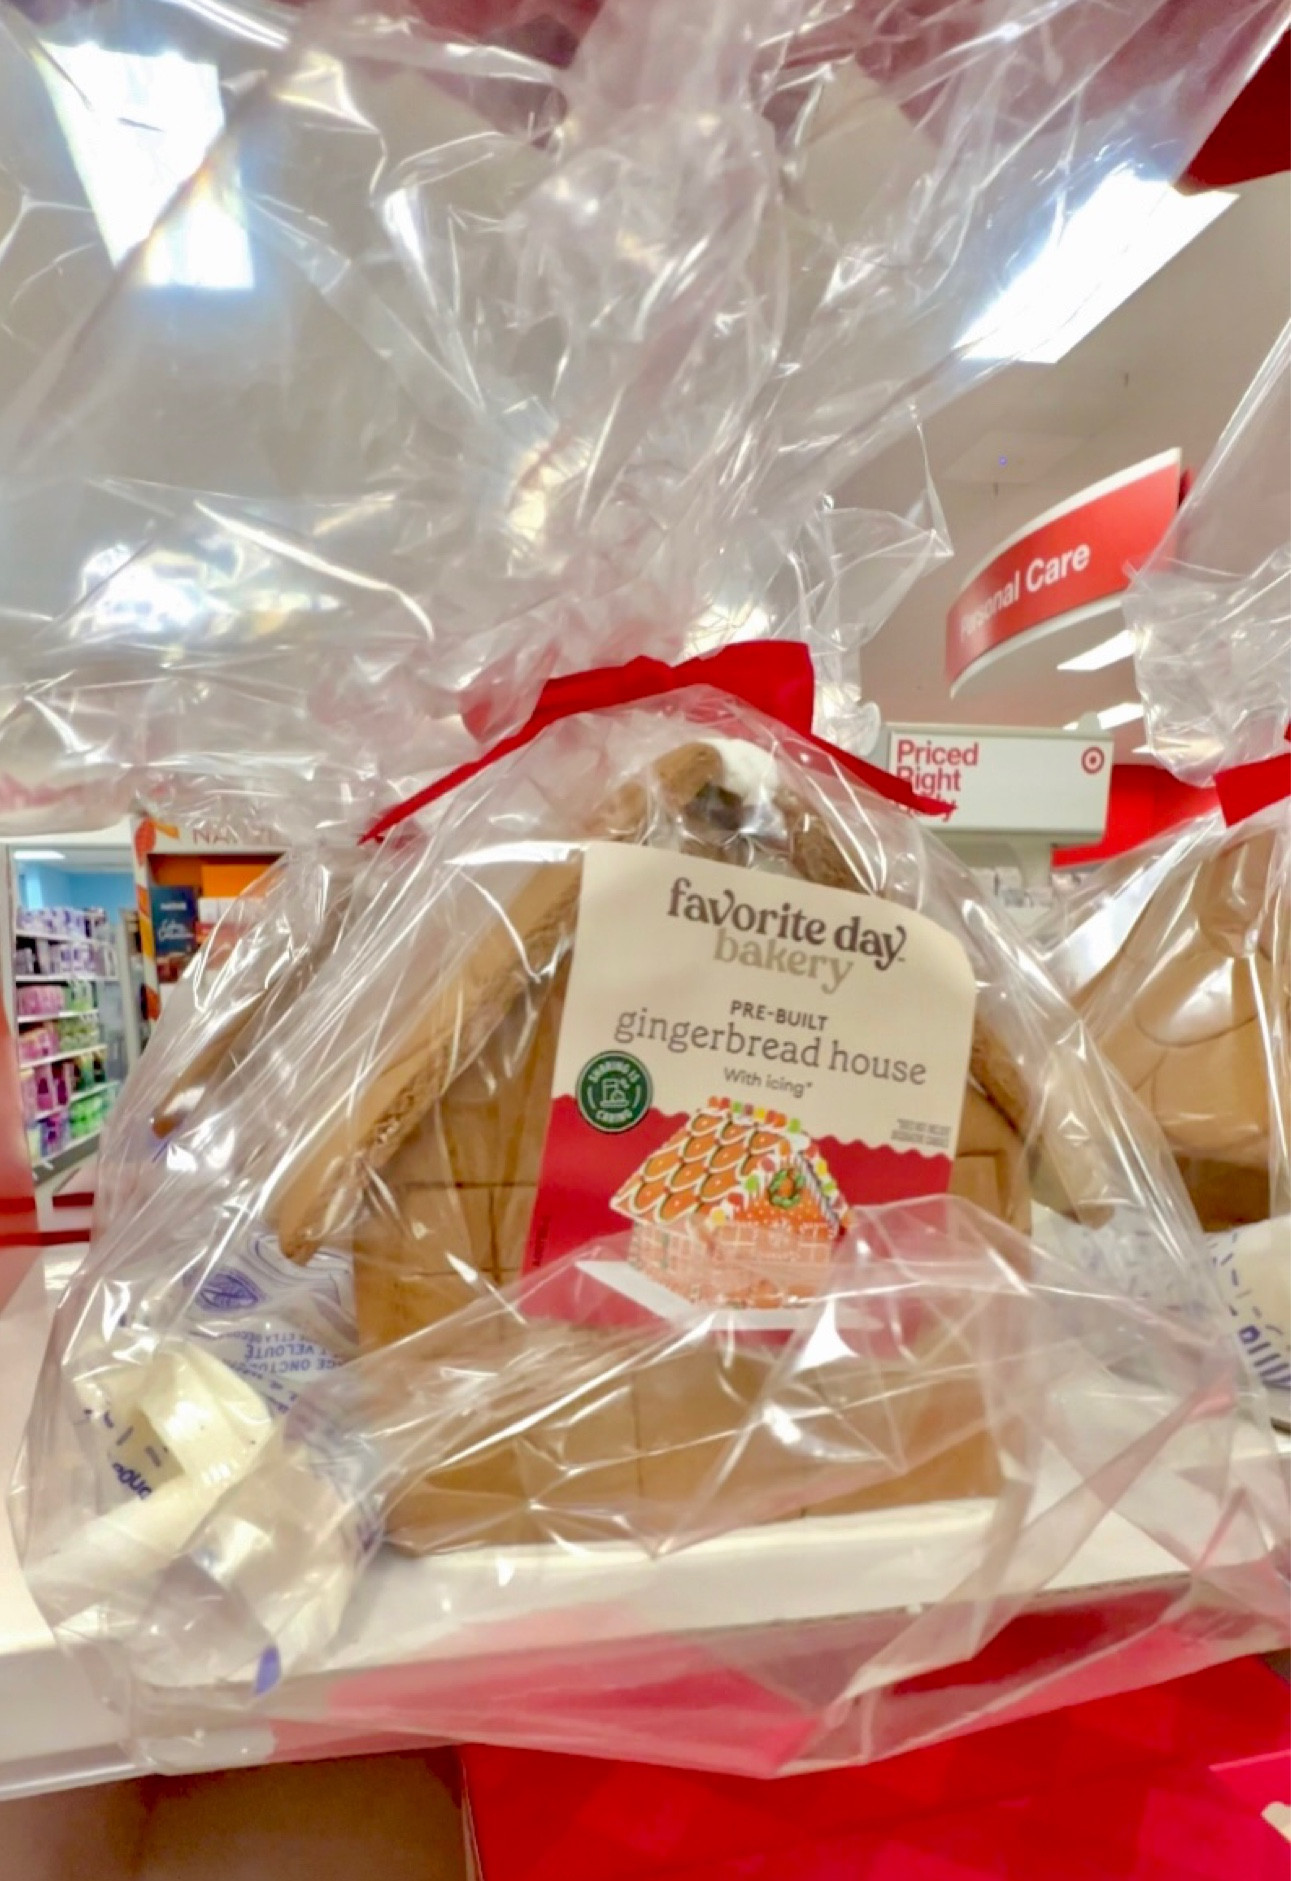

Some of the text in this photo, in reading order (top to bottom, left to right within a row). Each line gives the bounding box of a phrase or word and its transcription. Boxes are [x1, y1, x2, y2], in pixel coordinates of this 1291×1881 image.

[1026, 543, 1091, 593] Care
[897, 738, 980, 767] Priced
[667, 876, 907, 971] favorite day
[713, 928, 855, 995] bakery
[729, 1000, 830, 1032] PRE-BUILT
[613, 1008, 928, 1085] gingerbread house
[723, 1066, 762, 1090] With
